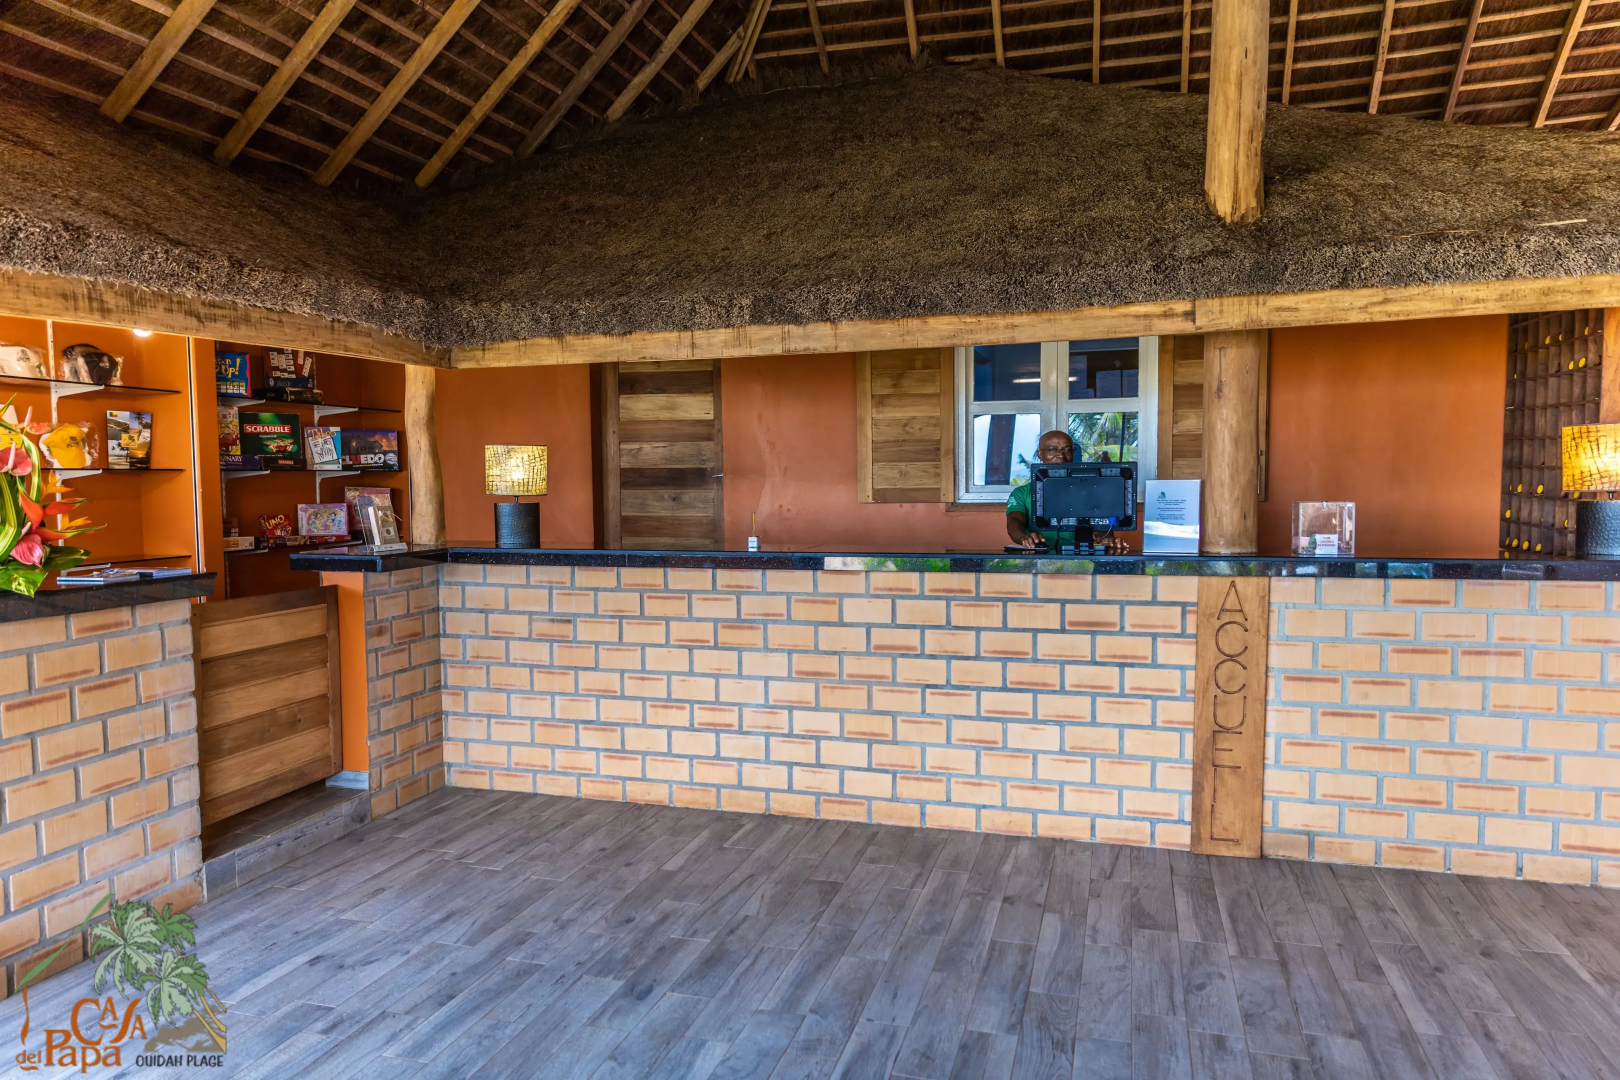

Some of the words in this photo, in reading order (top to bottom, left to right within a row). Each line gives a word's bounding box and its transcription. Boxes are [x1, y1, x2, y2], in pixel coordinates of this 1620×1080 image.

[245, 425, 290, 433] SCRABBLE
[308, 428, 337, 441] Taboo
[341, 453, 385, 465] CLUEDO
[265, 514, 285, 529] UNO
[1210, 580, 1249, 842] ACCUEIL
